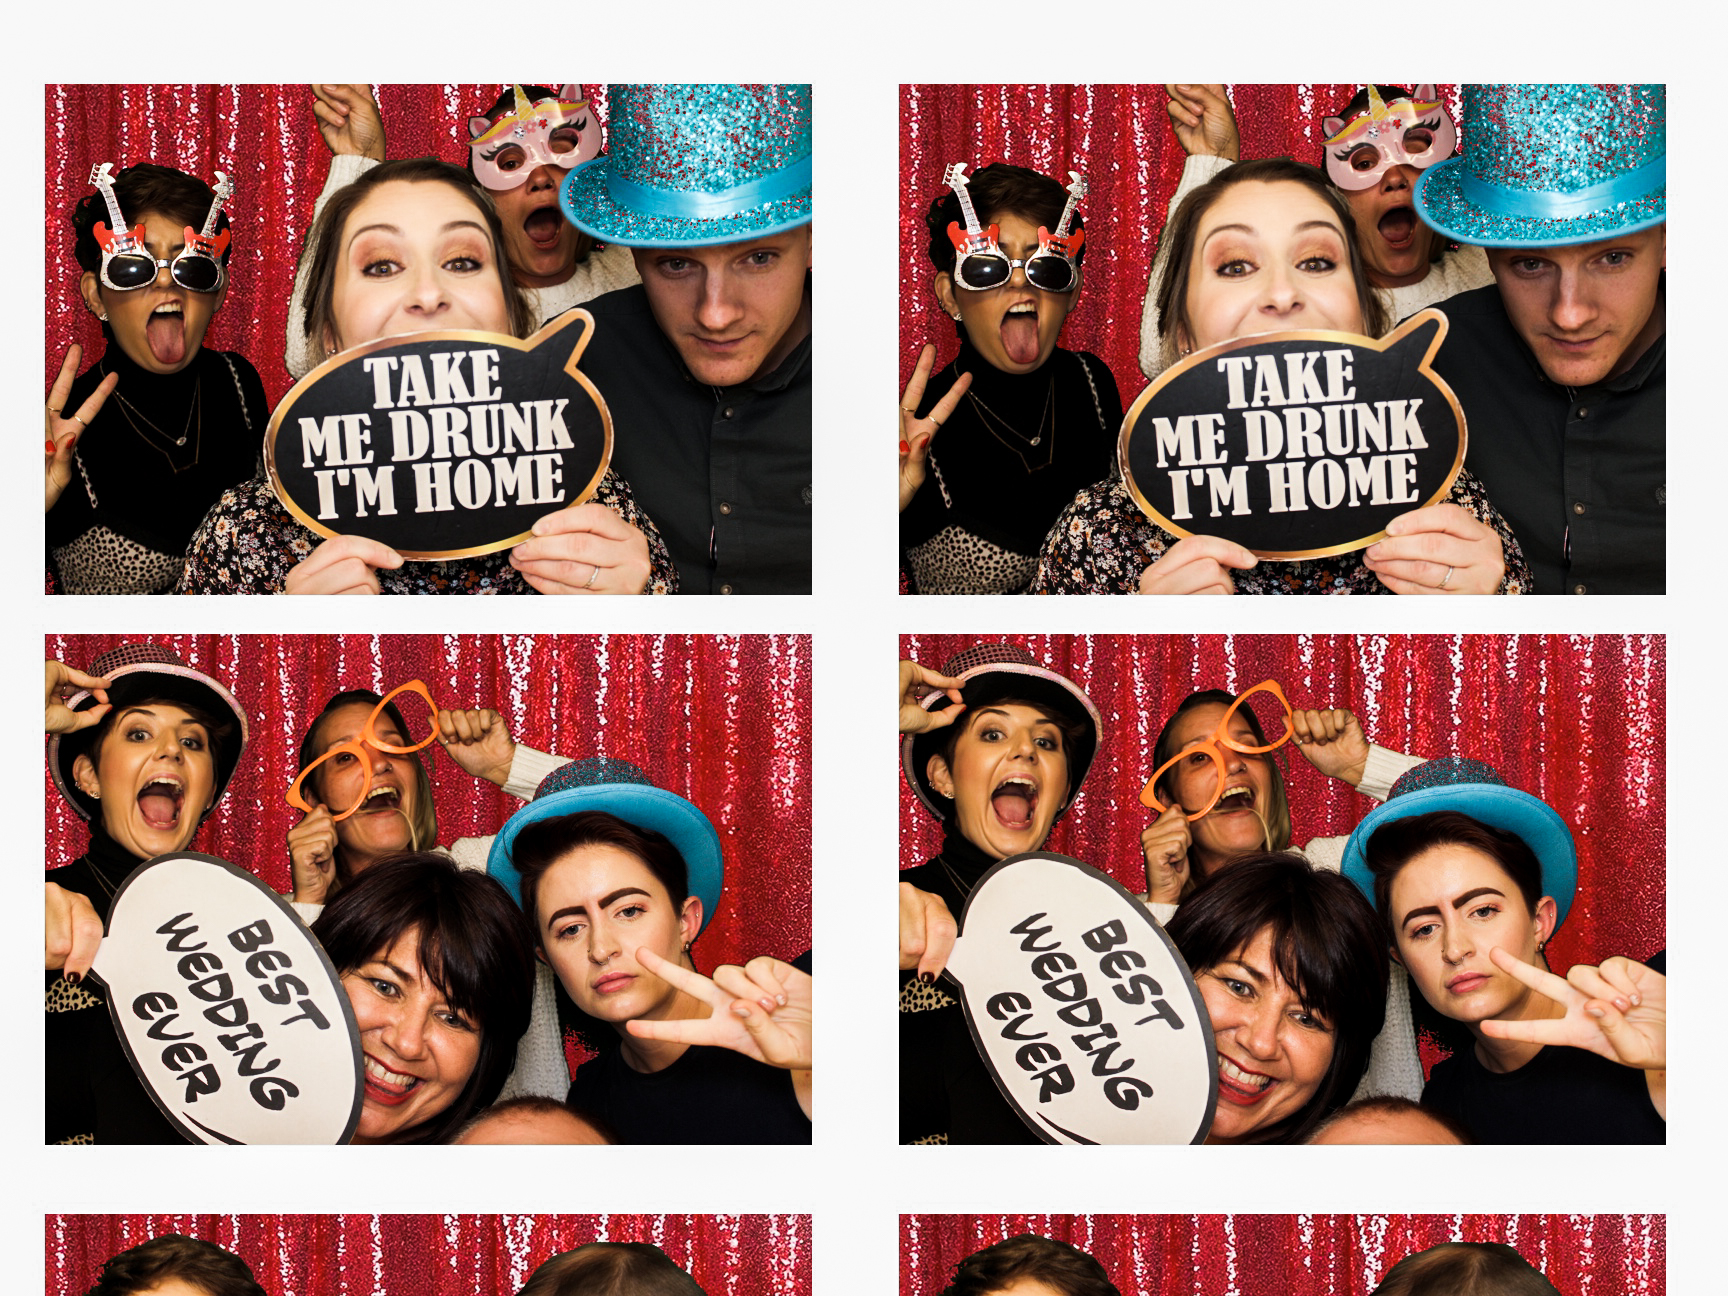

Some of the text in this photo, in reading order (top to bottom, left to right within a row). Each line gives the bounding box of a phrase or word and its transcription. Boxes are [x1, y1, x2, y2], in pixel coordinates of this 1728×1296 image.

[363, 349, 502, 409] TAKE
[1217, 349, 1356, 409] TAKE
[298, 399, 575, 468] ME DRUNK
[1152, 399, 1429, 468] ME DRUNK
[314, 453, 565, 519] I'M HOME
[1168, 453, 1419, 519] I'M HOME
[156, 912, 300, 1111] WEDDING
[227, 919, 331, 1030] BEST
[1010, 912, 1154, 1111] WEDDING
[1081, 919, 1185, 1030] BEST
[132, 991, 222, 1103] EVER
[986, 991, 1076, 1103] EVER
